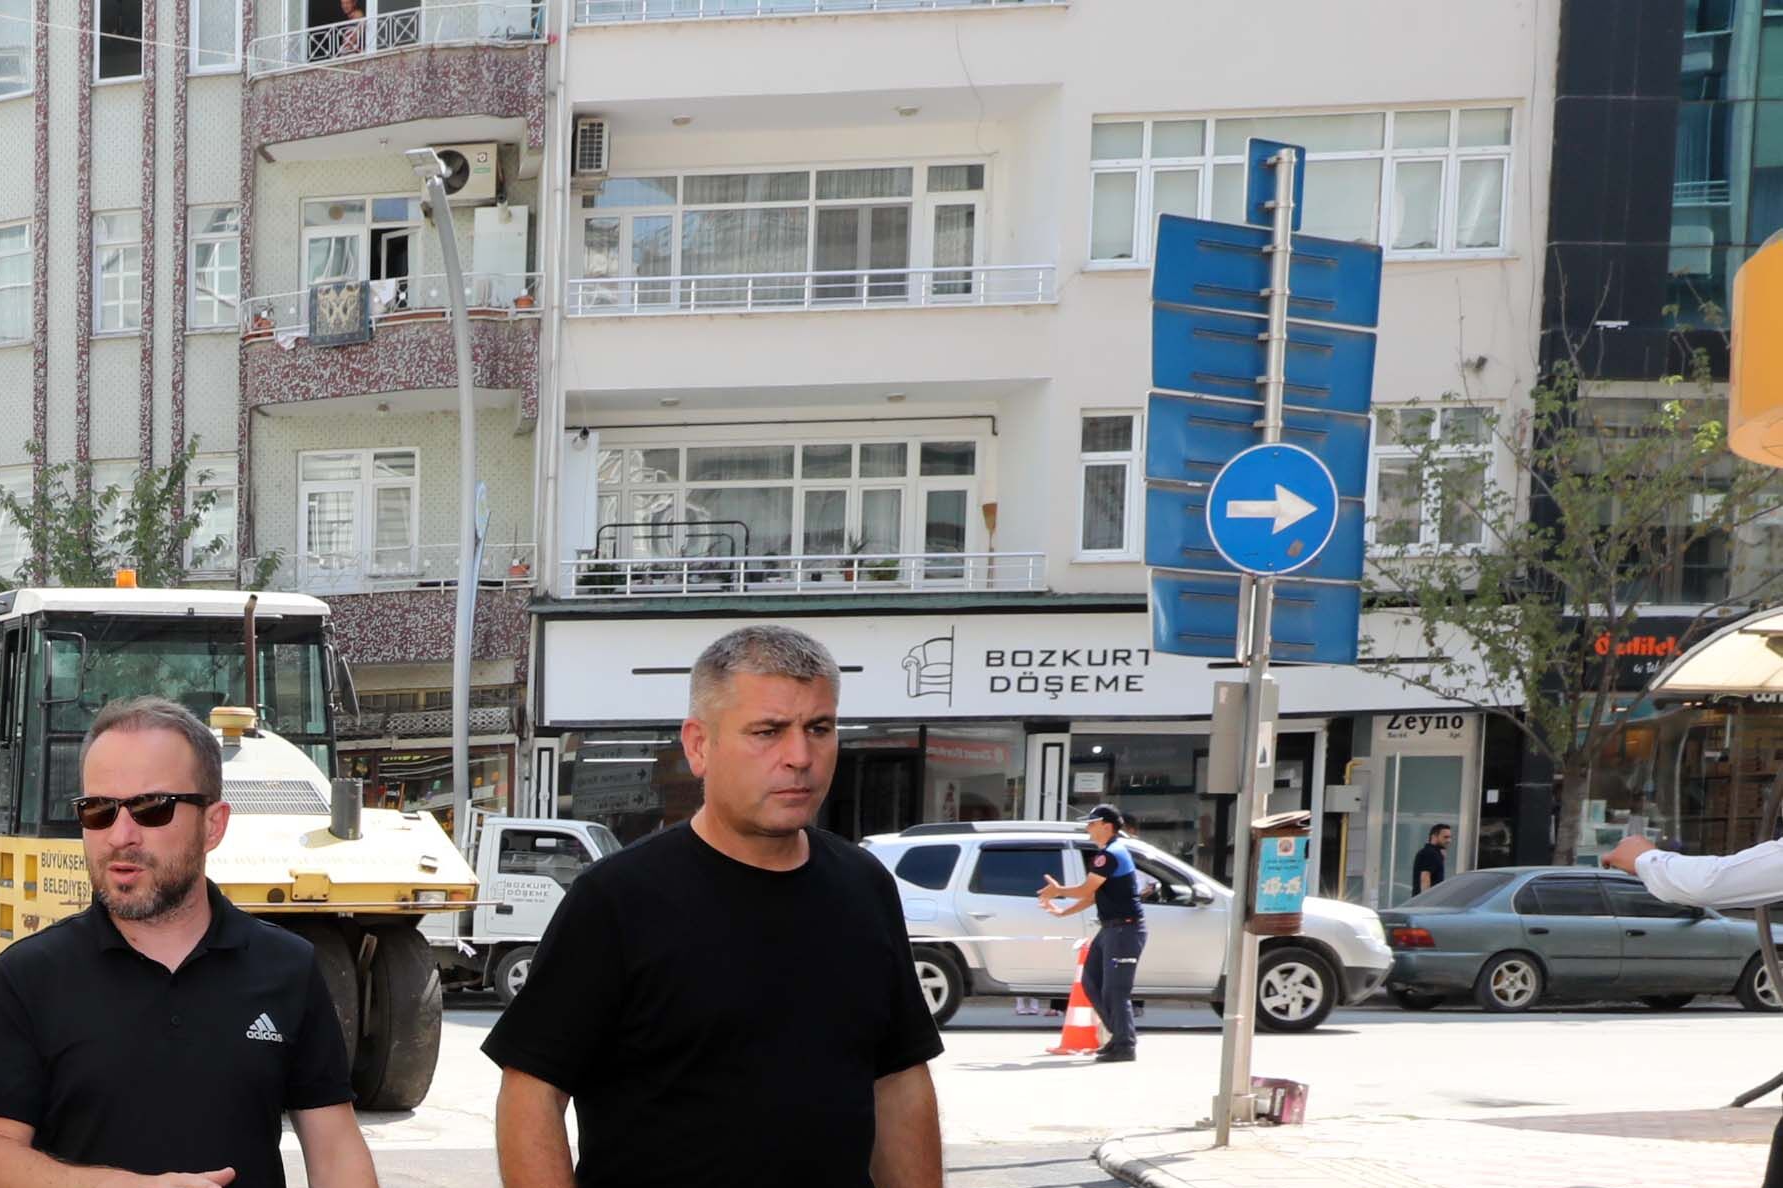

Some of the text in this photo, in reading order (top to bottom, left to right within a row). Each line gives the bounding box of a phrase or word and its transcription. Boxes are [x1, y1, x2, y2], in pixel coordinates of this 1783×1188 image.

[986, 649, 1150, 667] BOZKURT
[990, 671, 1144, 700] DÖŞEME
[1387, 713, 1465, 735] Zeyno
[246, 1030, 283, 1042] adidas
